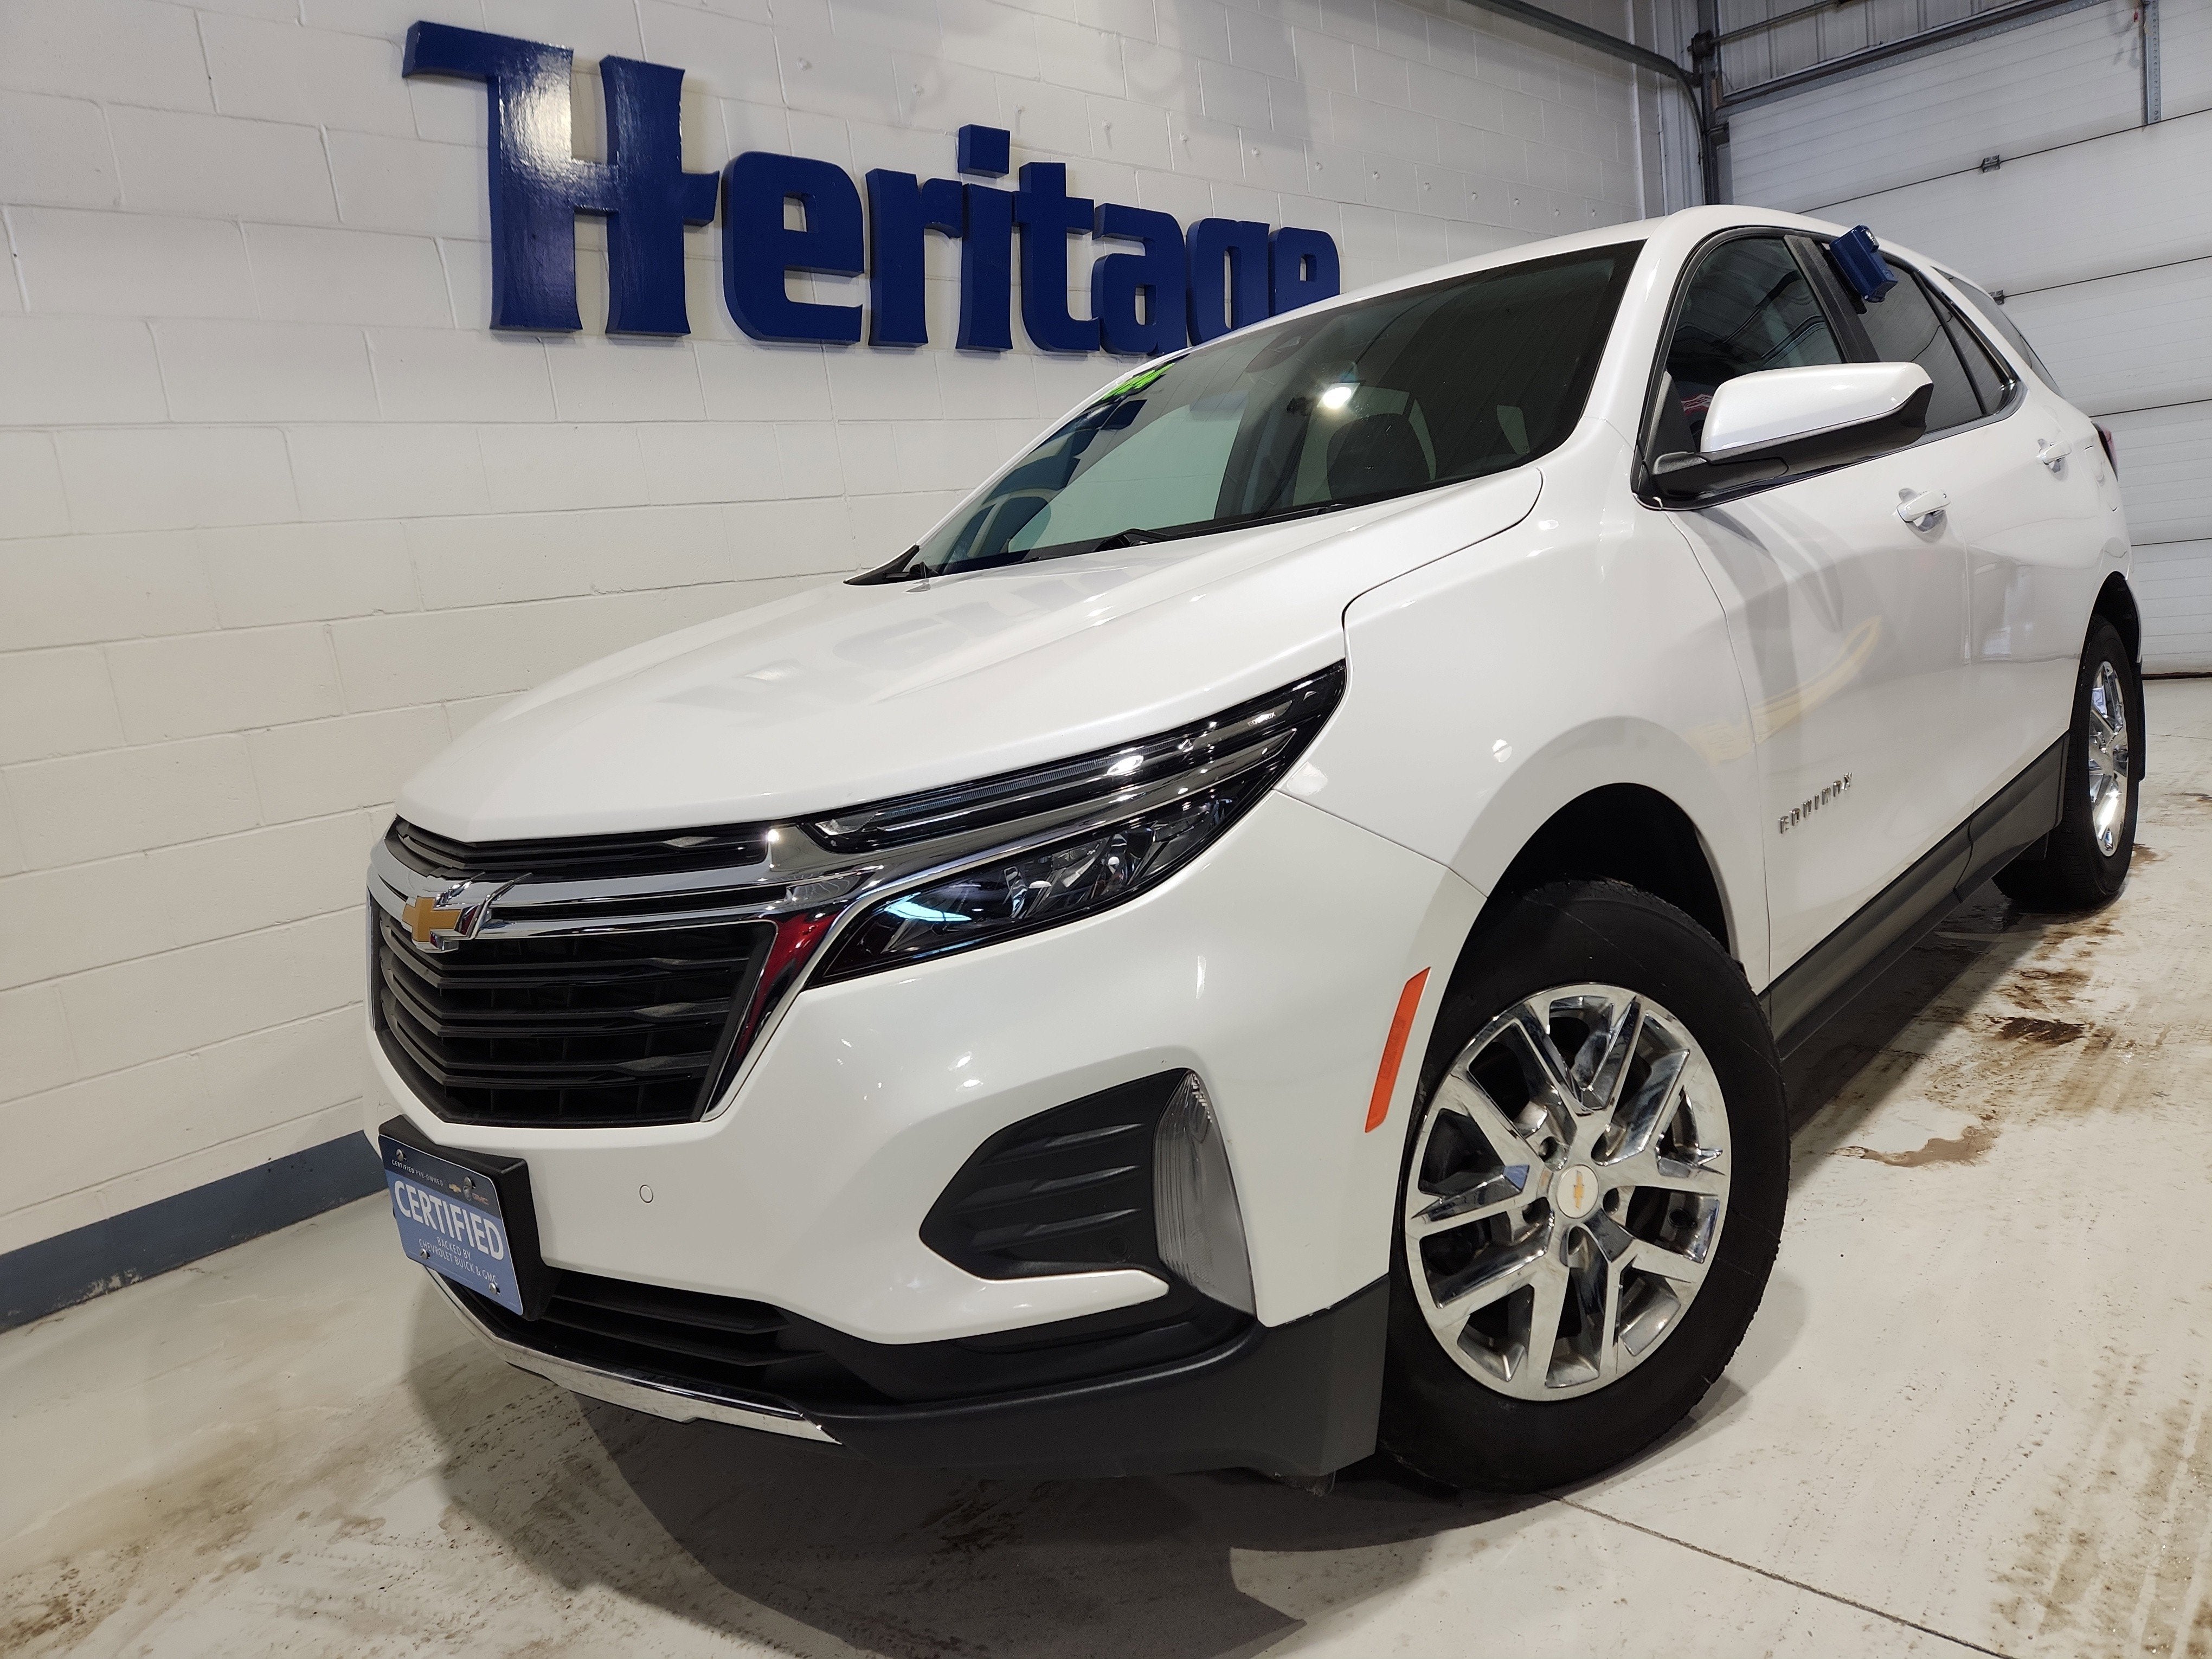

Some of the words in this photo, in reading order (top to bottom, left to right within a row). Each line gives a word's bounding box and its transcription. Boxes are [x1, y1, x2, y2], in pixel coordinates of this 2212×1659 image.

[402, 20, 1340, 356] Heritage
[1780, 772, 1852, 834] EQUINOX
[391, 1160, 415, 1174] CERTIFIED
[415, 1170, 443, 1186] PRE-OWNED
[394, 1180, 504, 1261] CERTIFIED
[419, 1238, 453, 1263] CHEVROLET
[454, 1256, 474, 1274] BUICK
[475, 1266, 481, 1277] &
[482, 1269, 498, 1285] GMC
[436, 1237, 461, 1256] BACKED
[462, 1249, 471, 1261] BY
